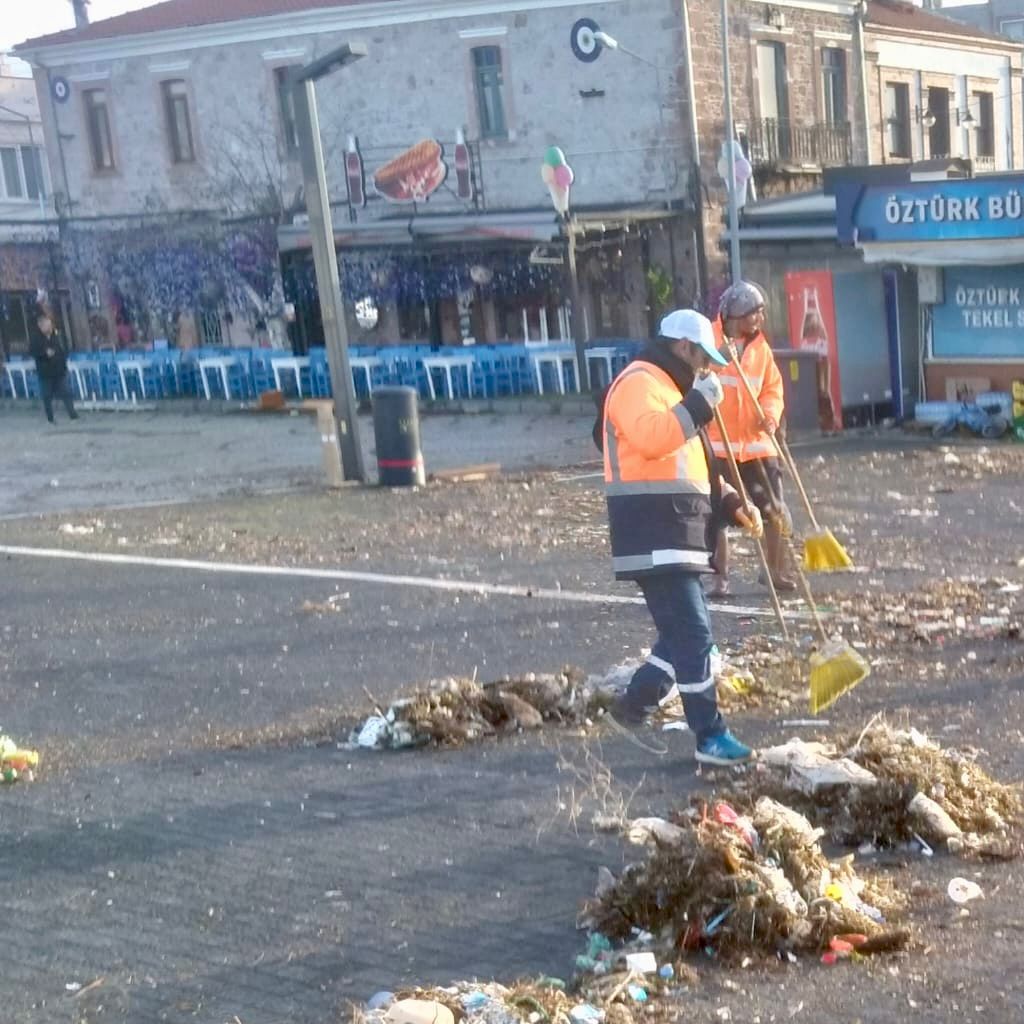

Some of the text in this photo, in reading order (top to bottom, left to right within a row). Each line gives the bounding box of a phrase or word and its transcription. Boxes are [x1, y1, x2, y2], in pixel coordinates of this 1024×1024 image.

[885, 194, 980, 224] ÖZTÜRK
[955, 284, 1021, 306] ÖZTÜRK
[962, 309, 1014, 328] TEKEL
